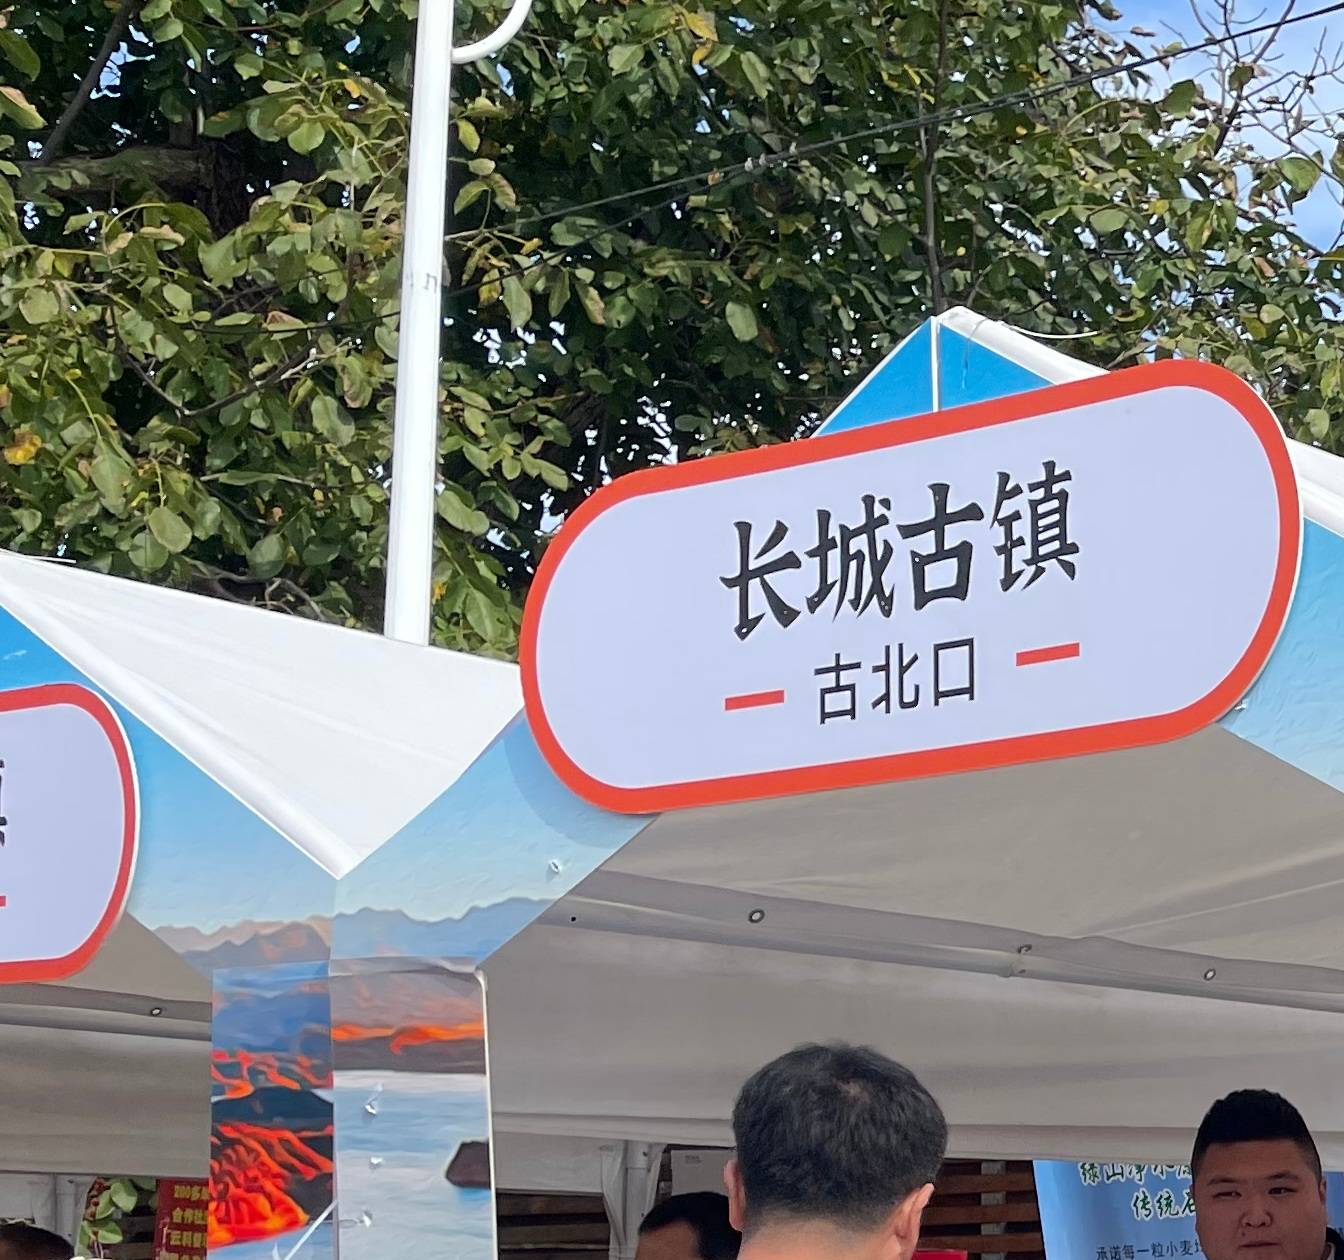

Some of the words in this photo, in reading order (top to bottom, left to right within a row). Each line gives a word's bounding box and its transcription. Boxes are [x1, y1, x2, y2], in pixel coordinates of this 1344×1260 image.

[719, 459, 1080, 640] 长城古镇
[813, 636, 977, 725] 古北口
